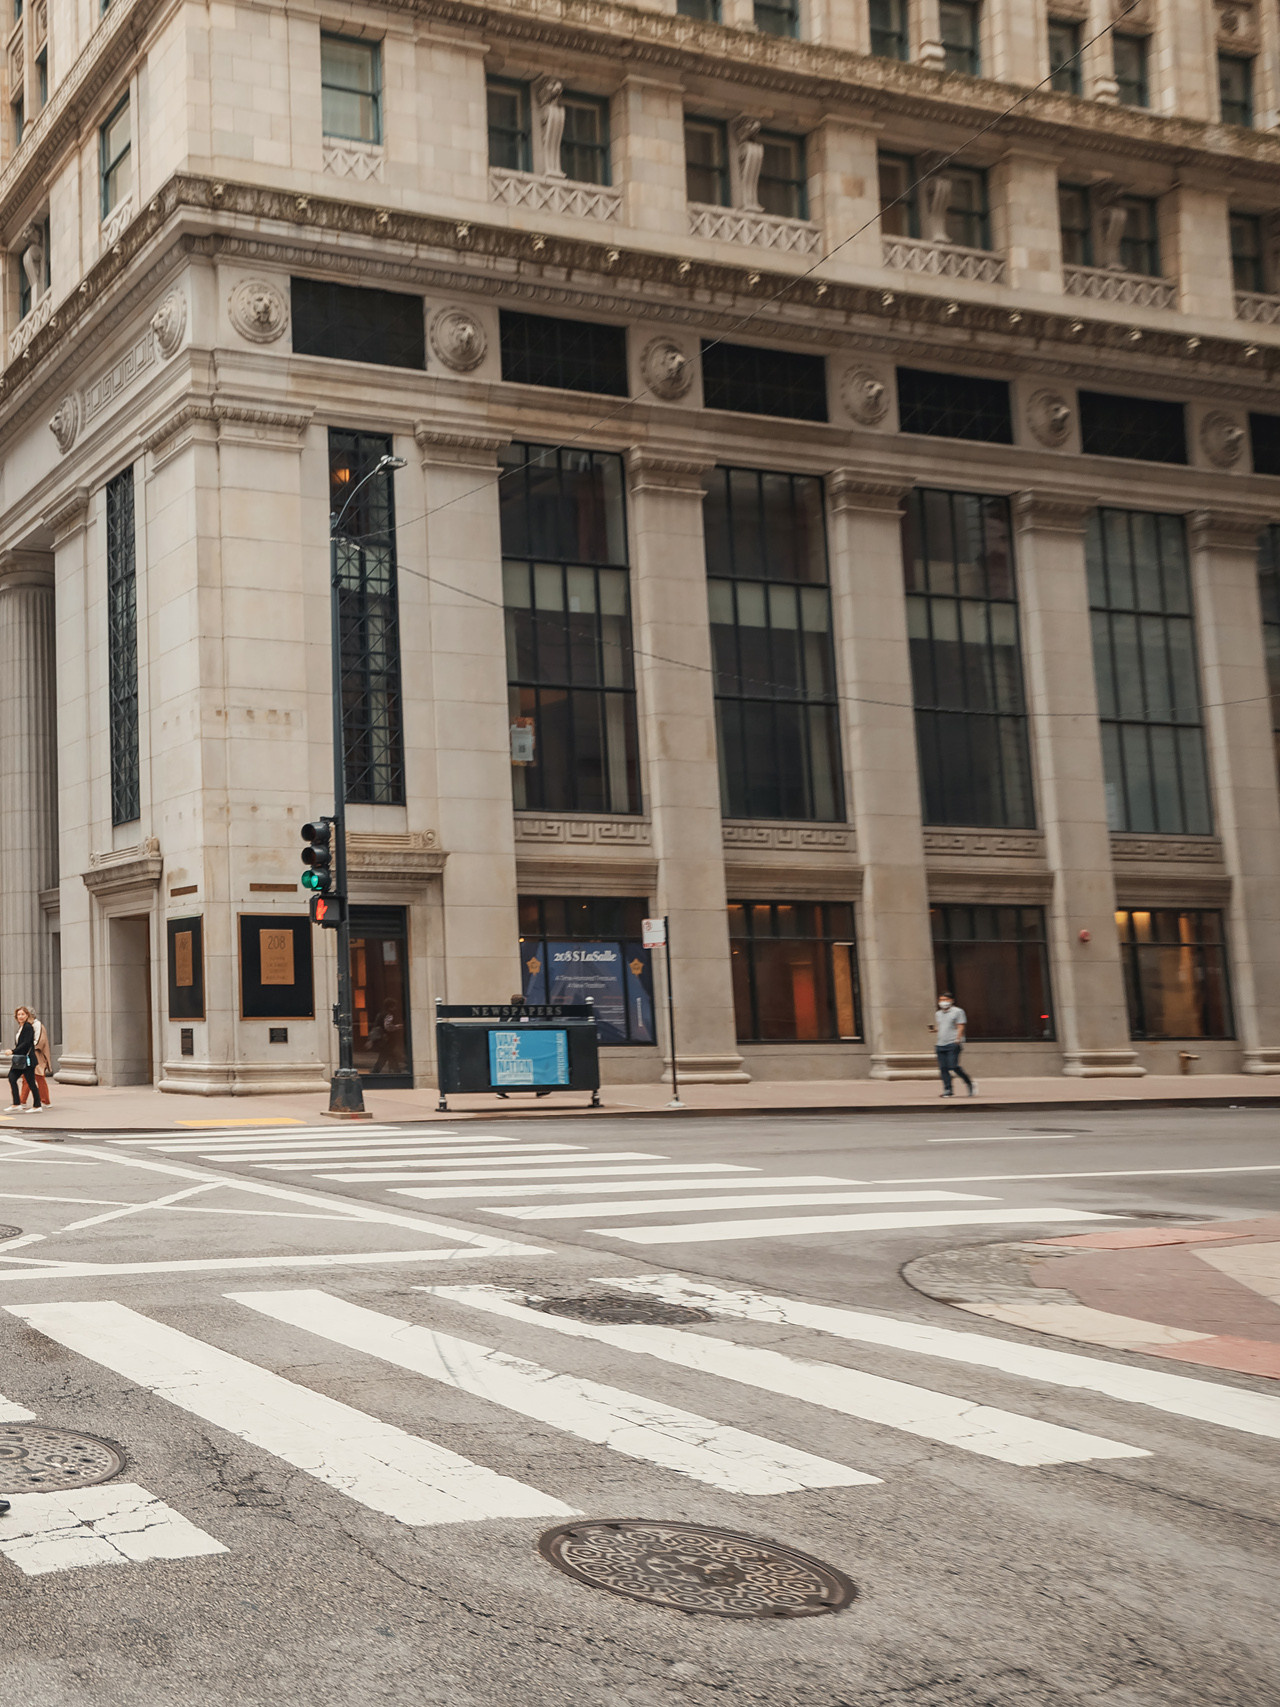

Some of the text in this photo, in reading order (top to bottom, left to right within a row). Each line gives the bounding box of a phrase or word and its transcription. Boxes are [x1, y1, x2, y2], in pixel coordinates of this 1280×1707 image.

[267, 935, 287, 950] 208
[554, 950, 617, 962] 208 S LaSalle
[471, 1006, 562, 1017] NEWSPAPERS
